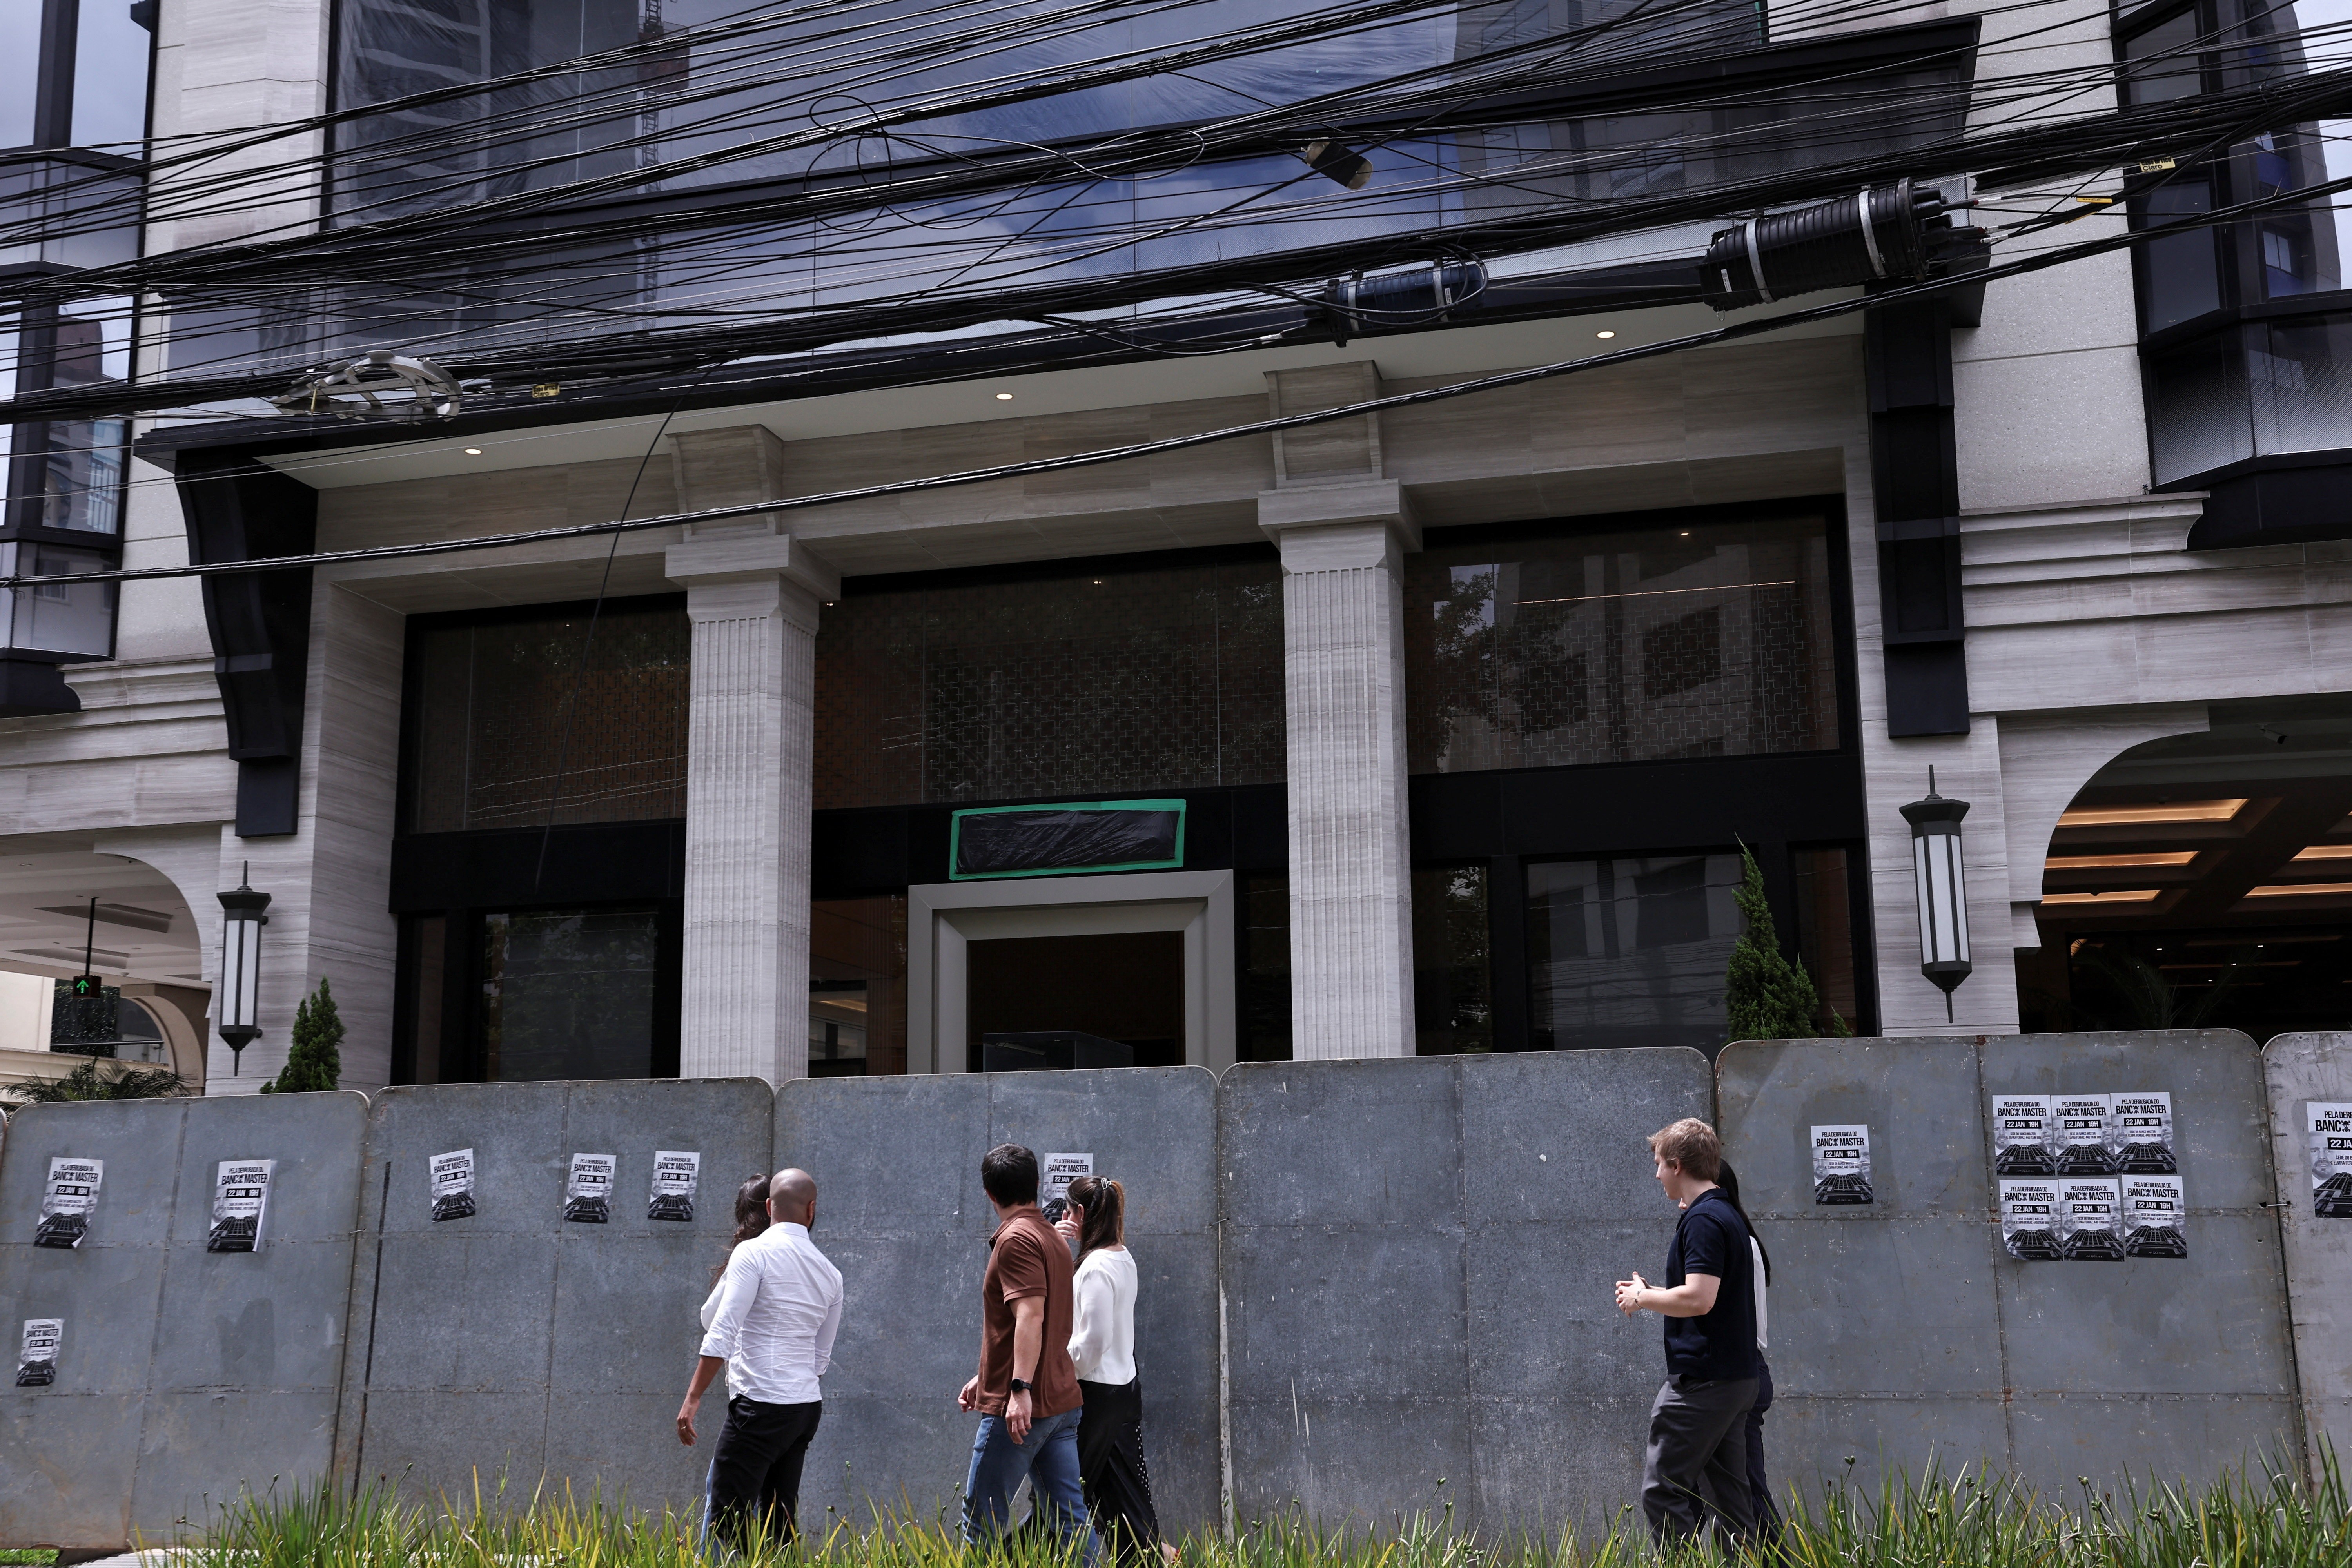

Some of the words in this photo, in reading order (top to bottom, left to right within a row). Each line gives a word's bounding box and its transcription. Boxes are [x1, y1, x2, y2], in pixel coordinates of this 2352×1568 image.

[2081, 1107, 2106, 1116] MASTER
[1840, 1138, 1864, 1146] MASTER
[2330, 1139, 2341, 1148] 22
[2343, 1139, 2352, 1148] JA
[2153, 1189, 2179, 1198] MASTER
